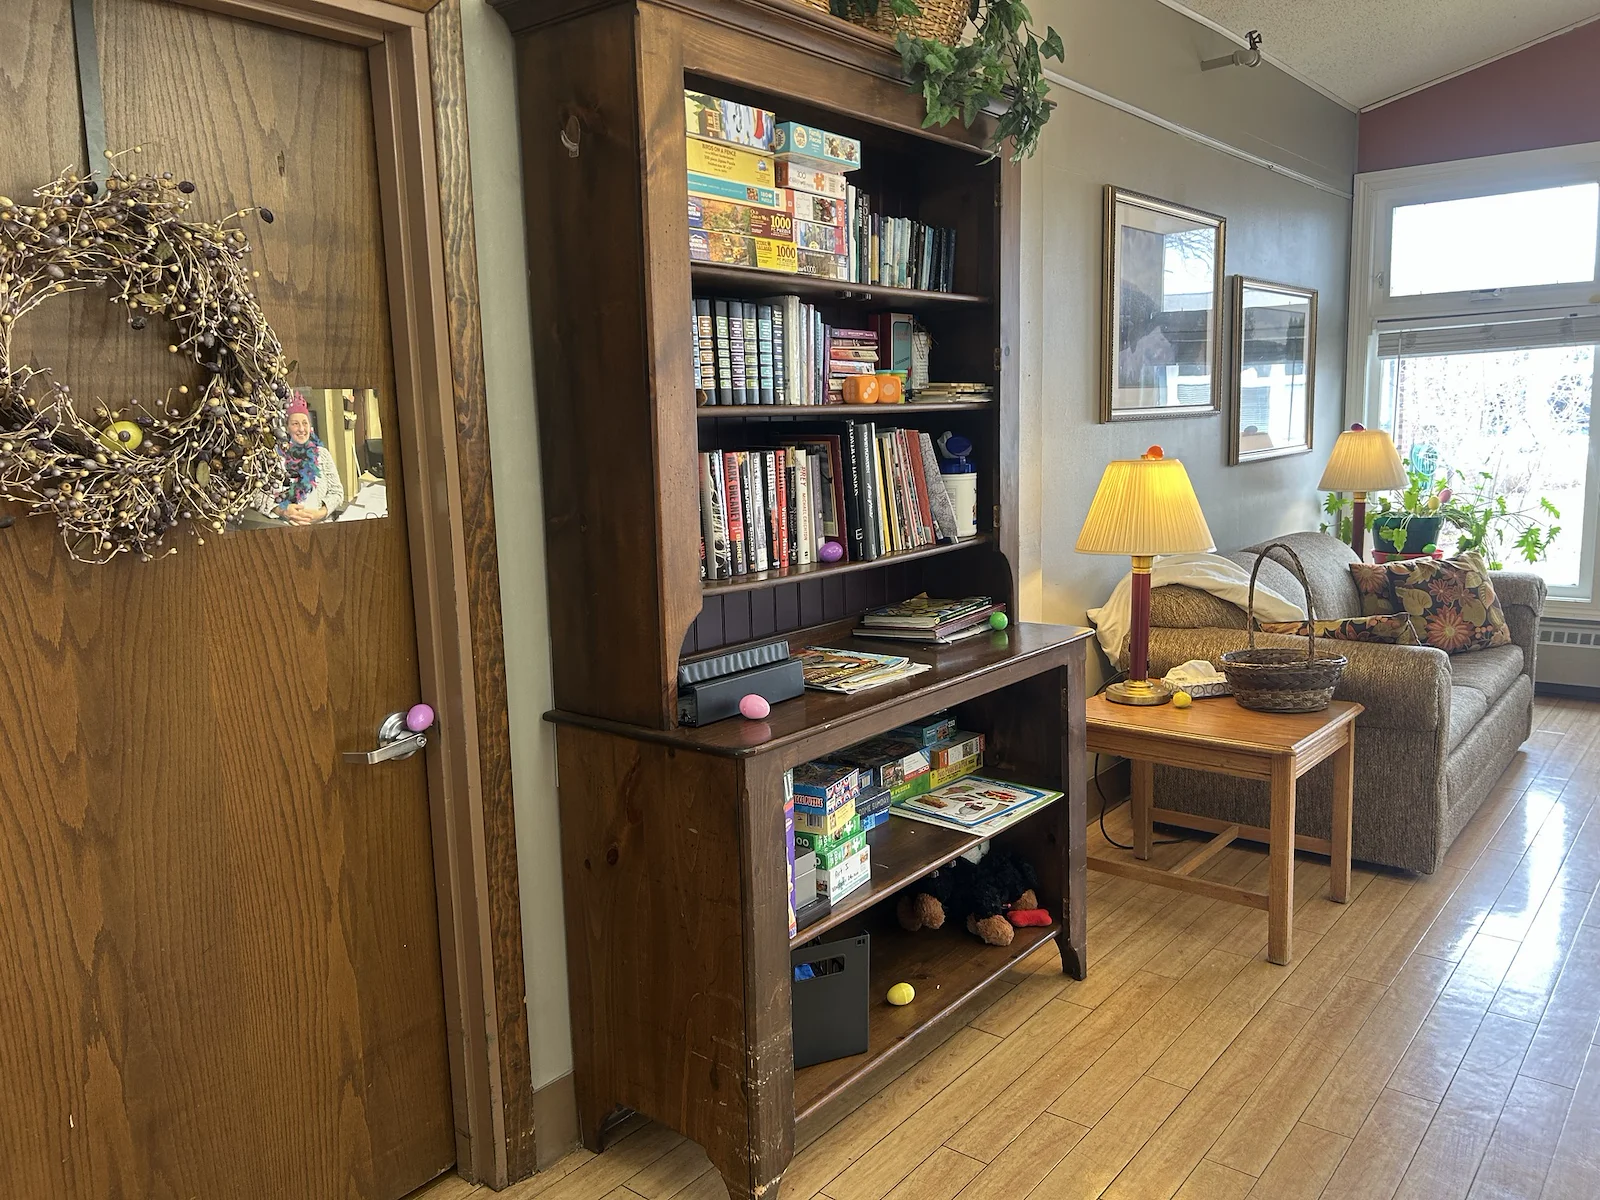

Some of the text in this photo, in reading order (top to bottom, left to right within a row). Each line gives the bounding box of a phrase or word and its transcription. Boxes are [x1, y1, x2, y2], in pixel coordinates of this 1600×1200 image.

[770, 216, 791, 230] 1000
[776, 245, 796, 258] 1000
[727, 456, 737, 482] MARK
[728, 484, 740, 522] GREANEY
